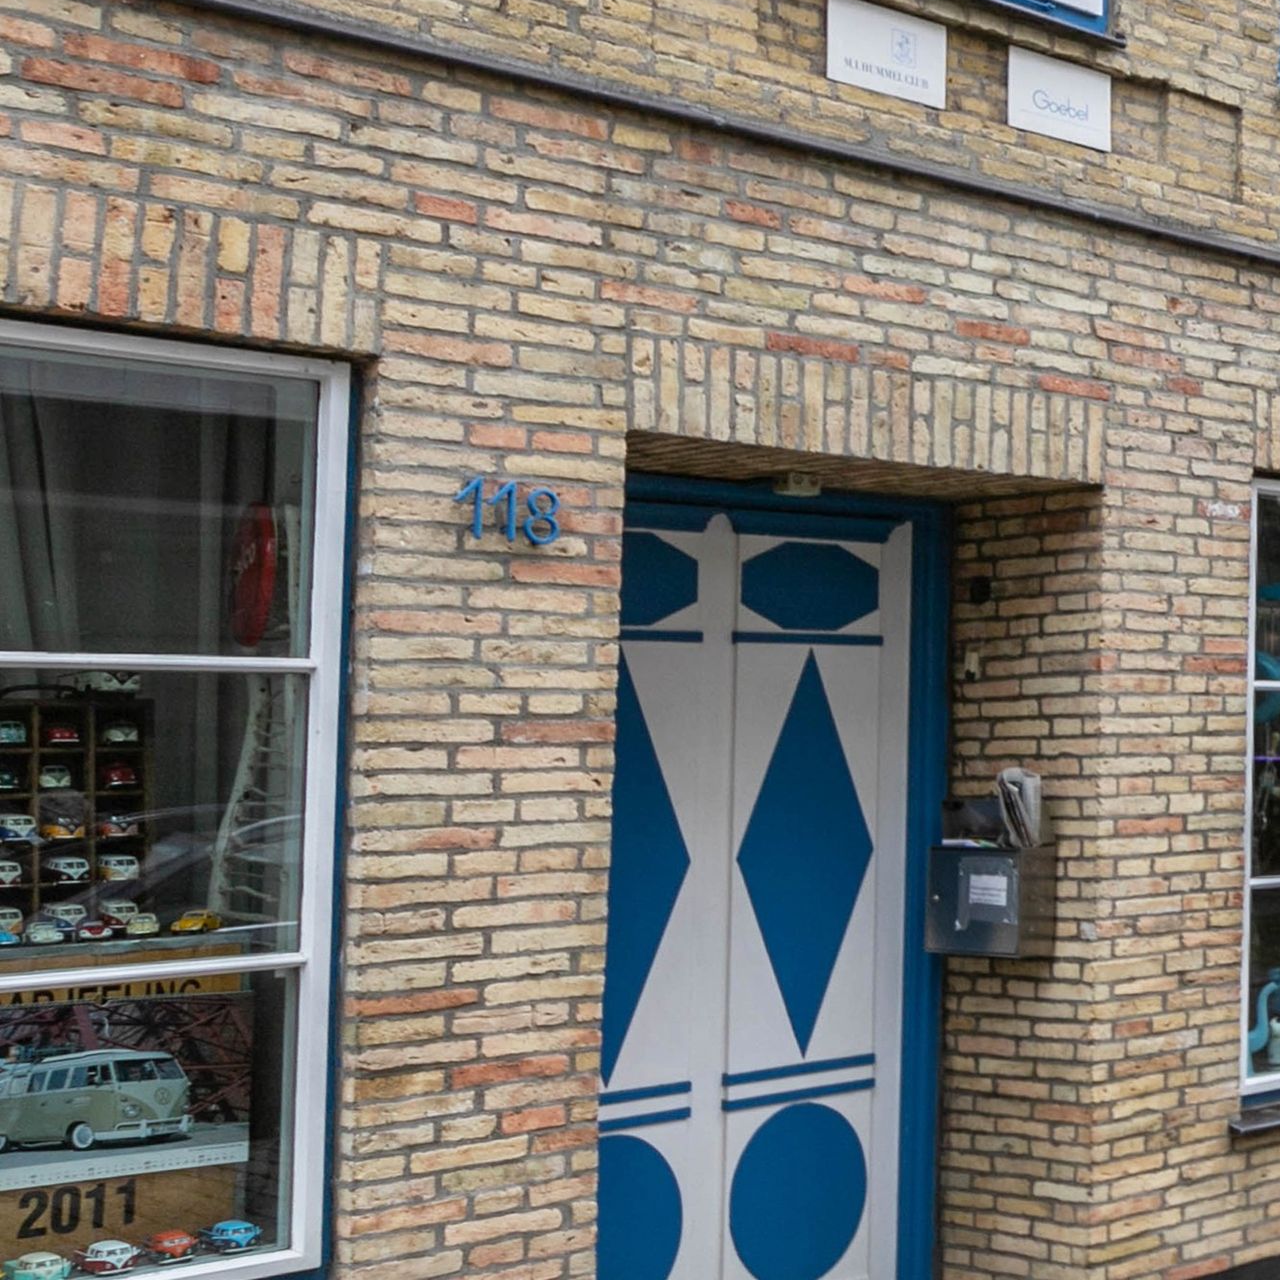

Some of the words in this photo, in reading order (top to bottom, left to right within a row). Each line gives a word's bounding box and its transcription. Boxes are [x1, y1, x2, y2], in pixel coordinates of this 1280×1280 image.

[1032, 89, 1089, 122] Goebel
[452, 474, 561, 546] 118
[16, 1179, 136, 1239] 2011
